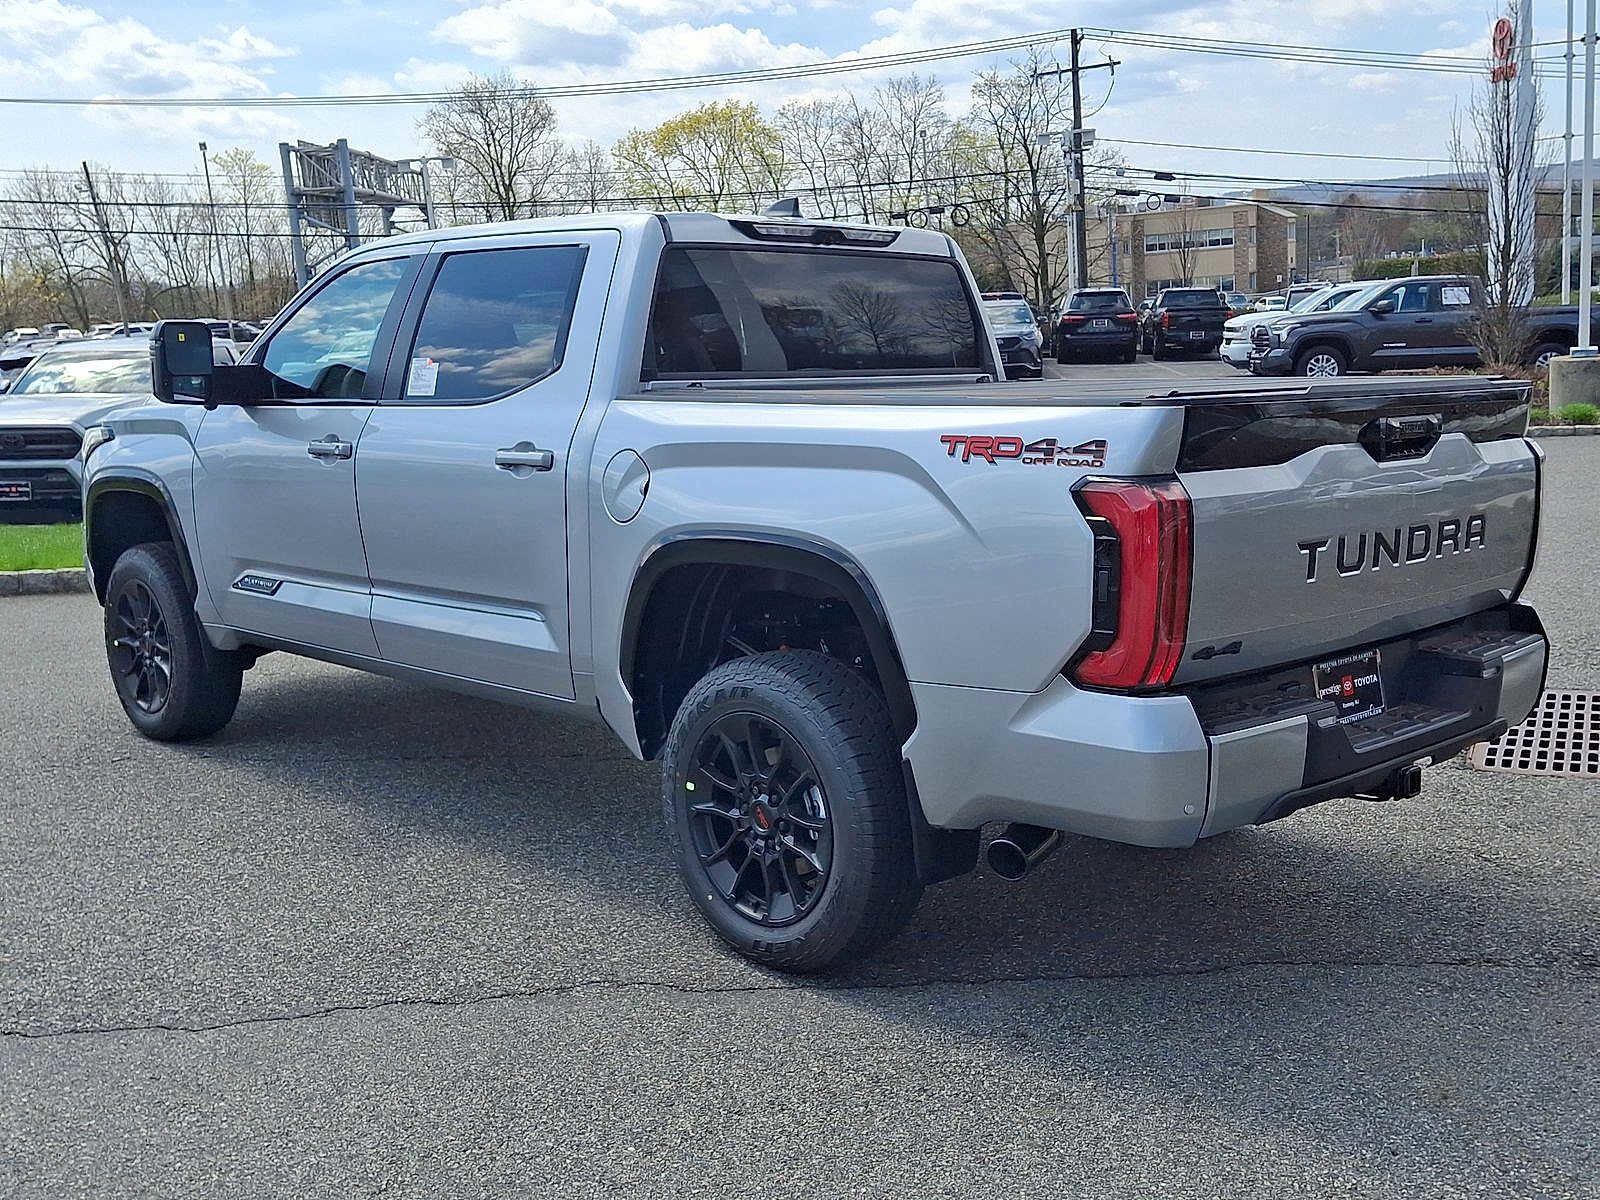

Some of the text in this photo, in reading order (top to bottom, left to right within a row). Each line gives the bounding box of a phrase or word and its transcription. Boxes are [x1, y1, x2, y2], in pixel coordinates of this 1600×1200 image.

[940, 435, 1108, 466] TRD 4x4
[1022, 457, 1105, 469] OFF ROAD
[1296, 514, 1487, 584] TUNDRA
[1320, 674, 1378, 700] prestige TOYOTA
